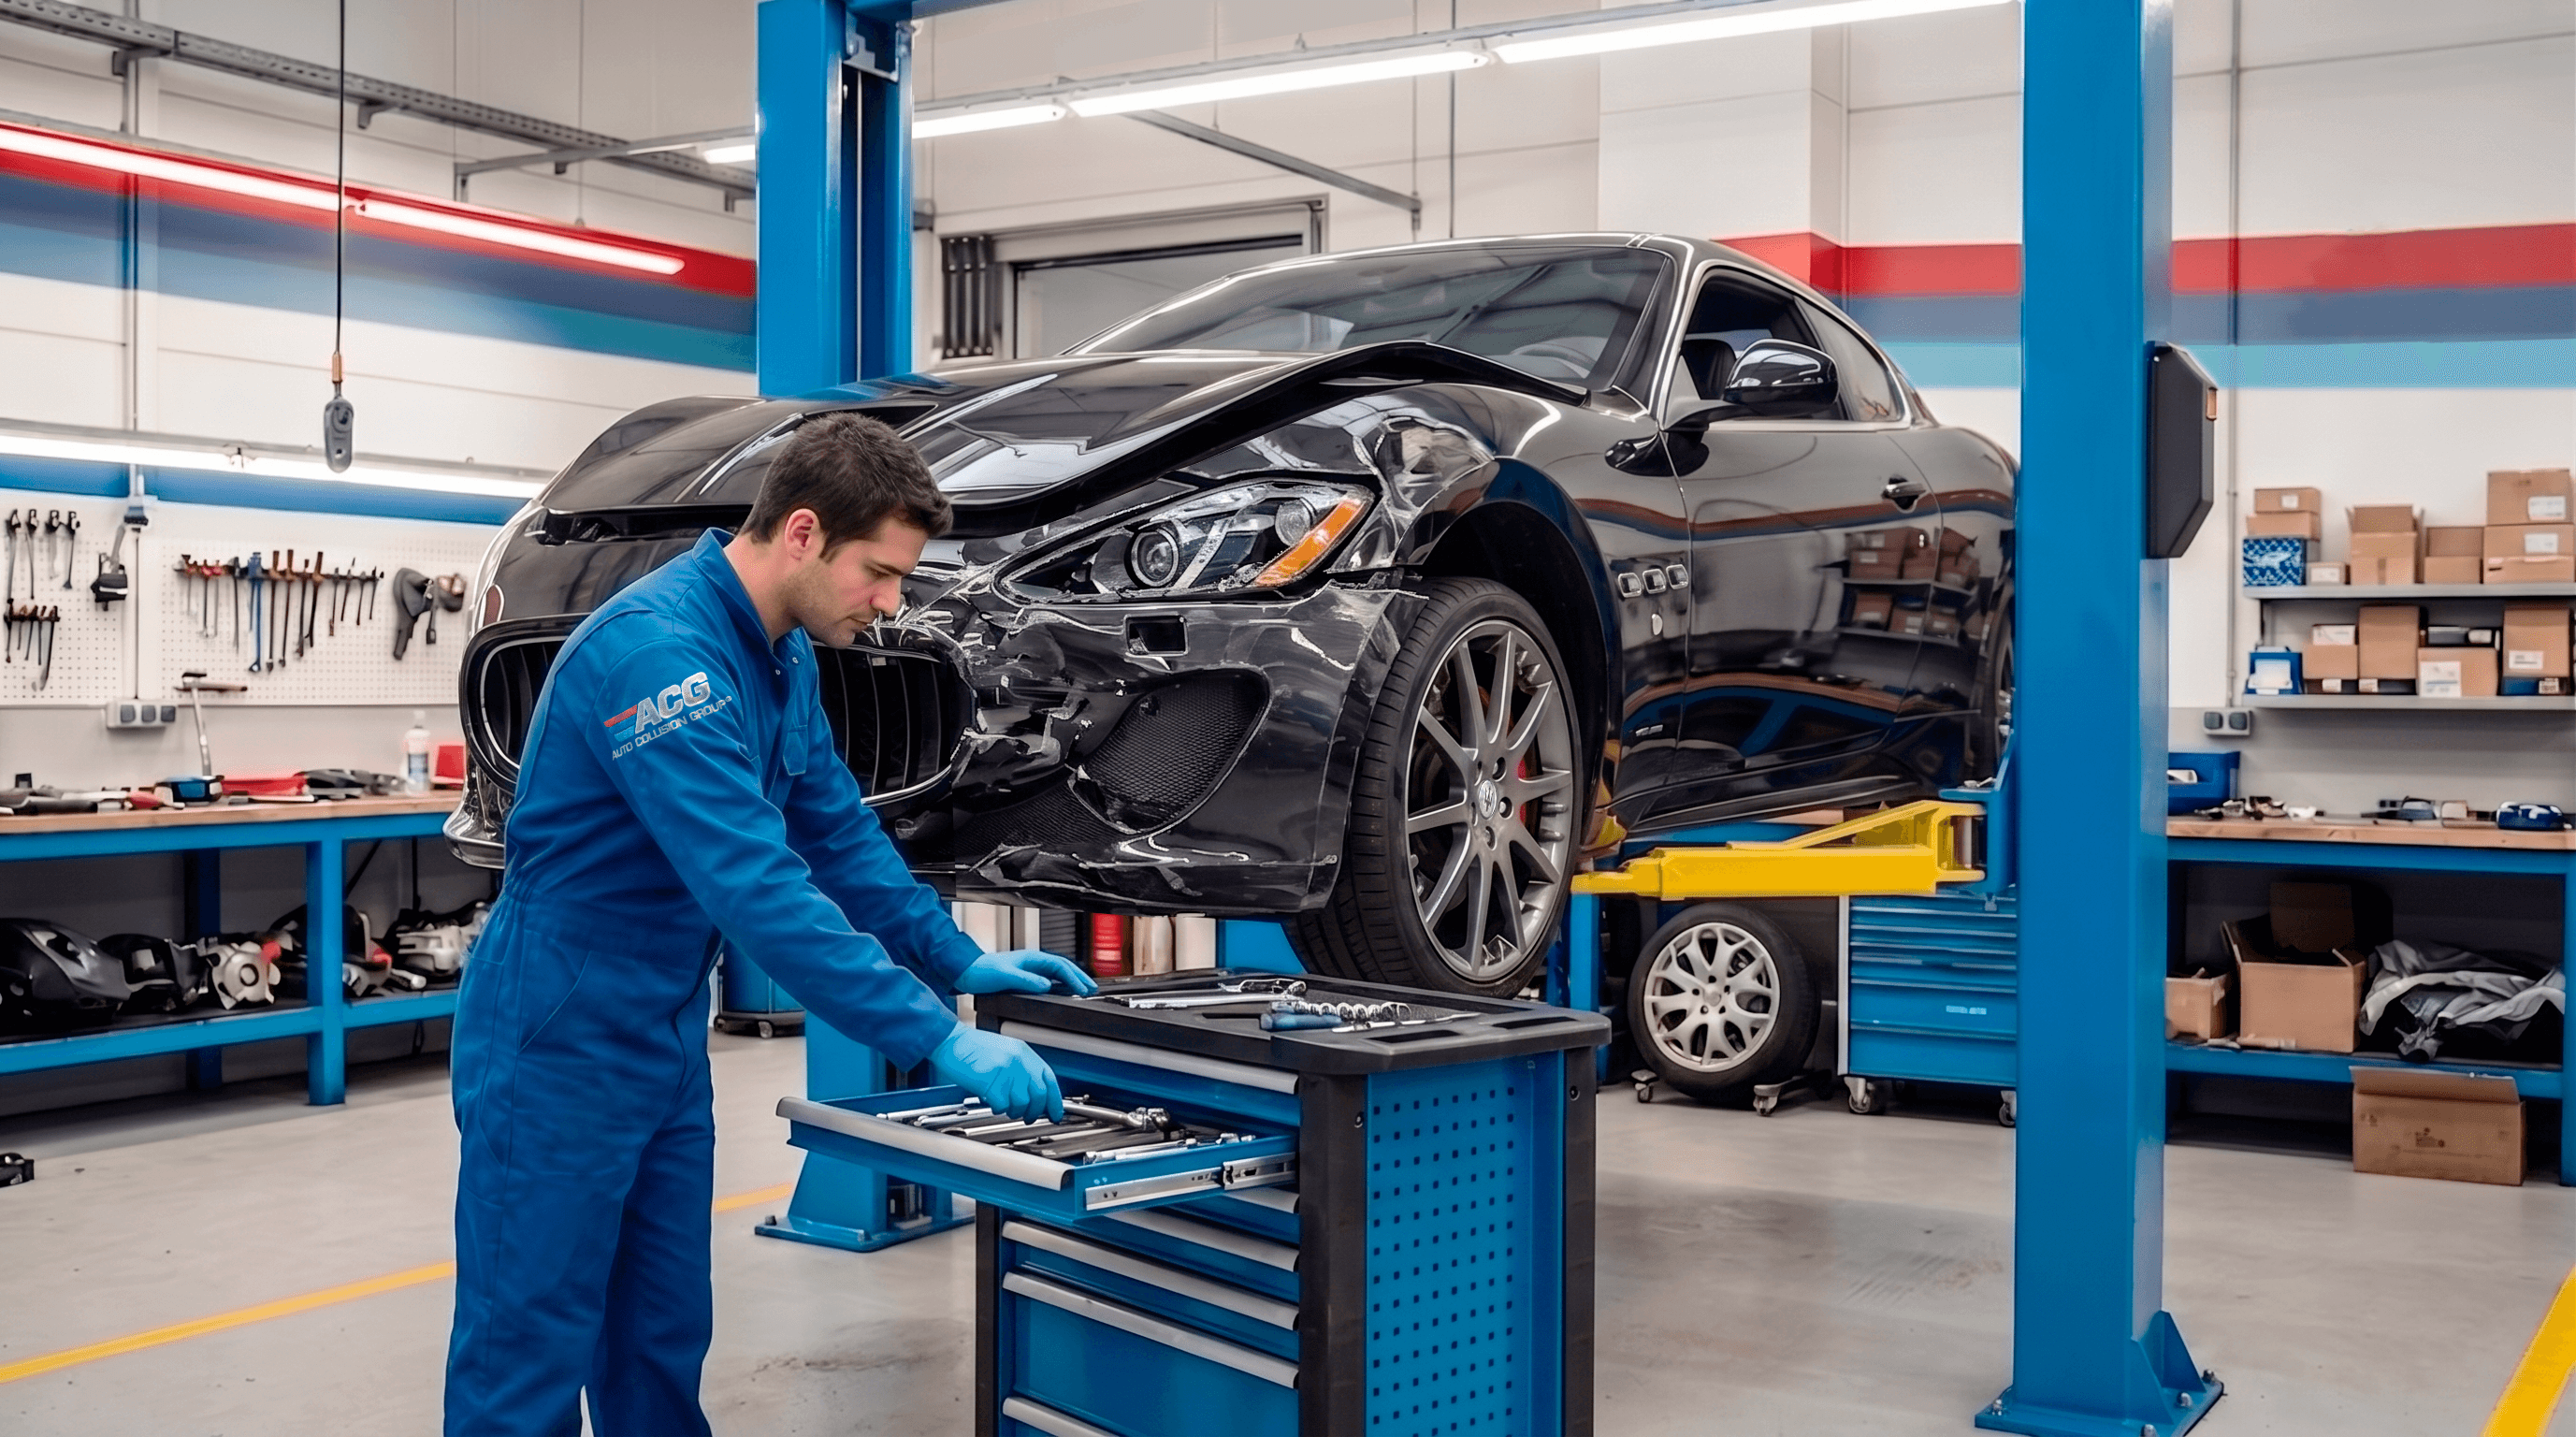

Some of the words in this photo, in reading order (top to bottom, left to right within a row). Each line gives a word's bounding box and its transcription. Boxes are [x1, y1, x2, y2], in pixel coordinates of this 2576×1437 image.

[635, 672, 711, 733] ACG
[612, 742, 633, 761] AUTO
[635, 716, 687, 747] COLLISION
